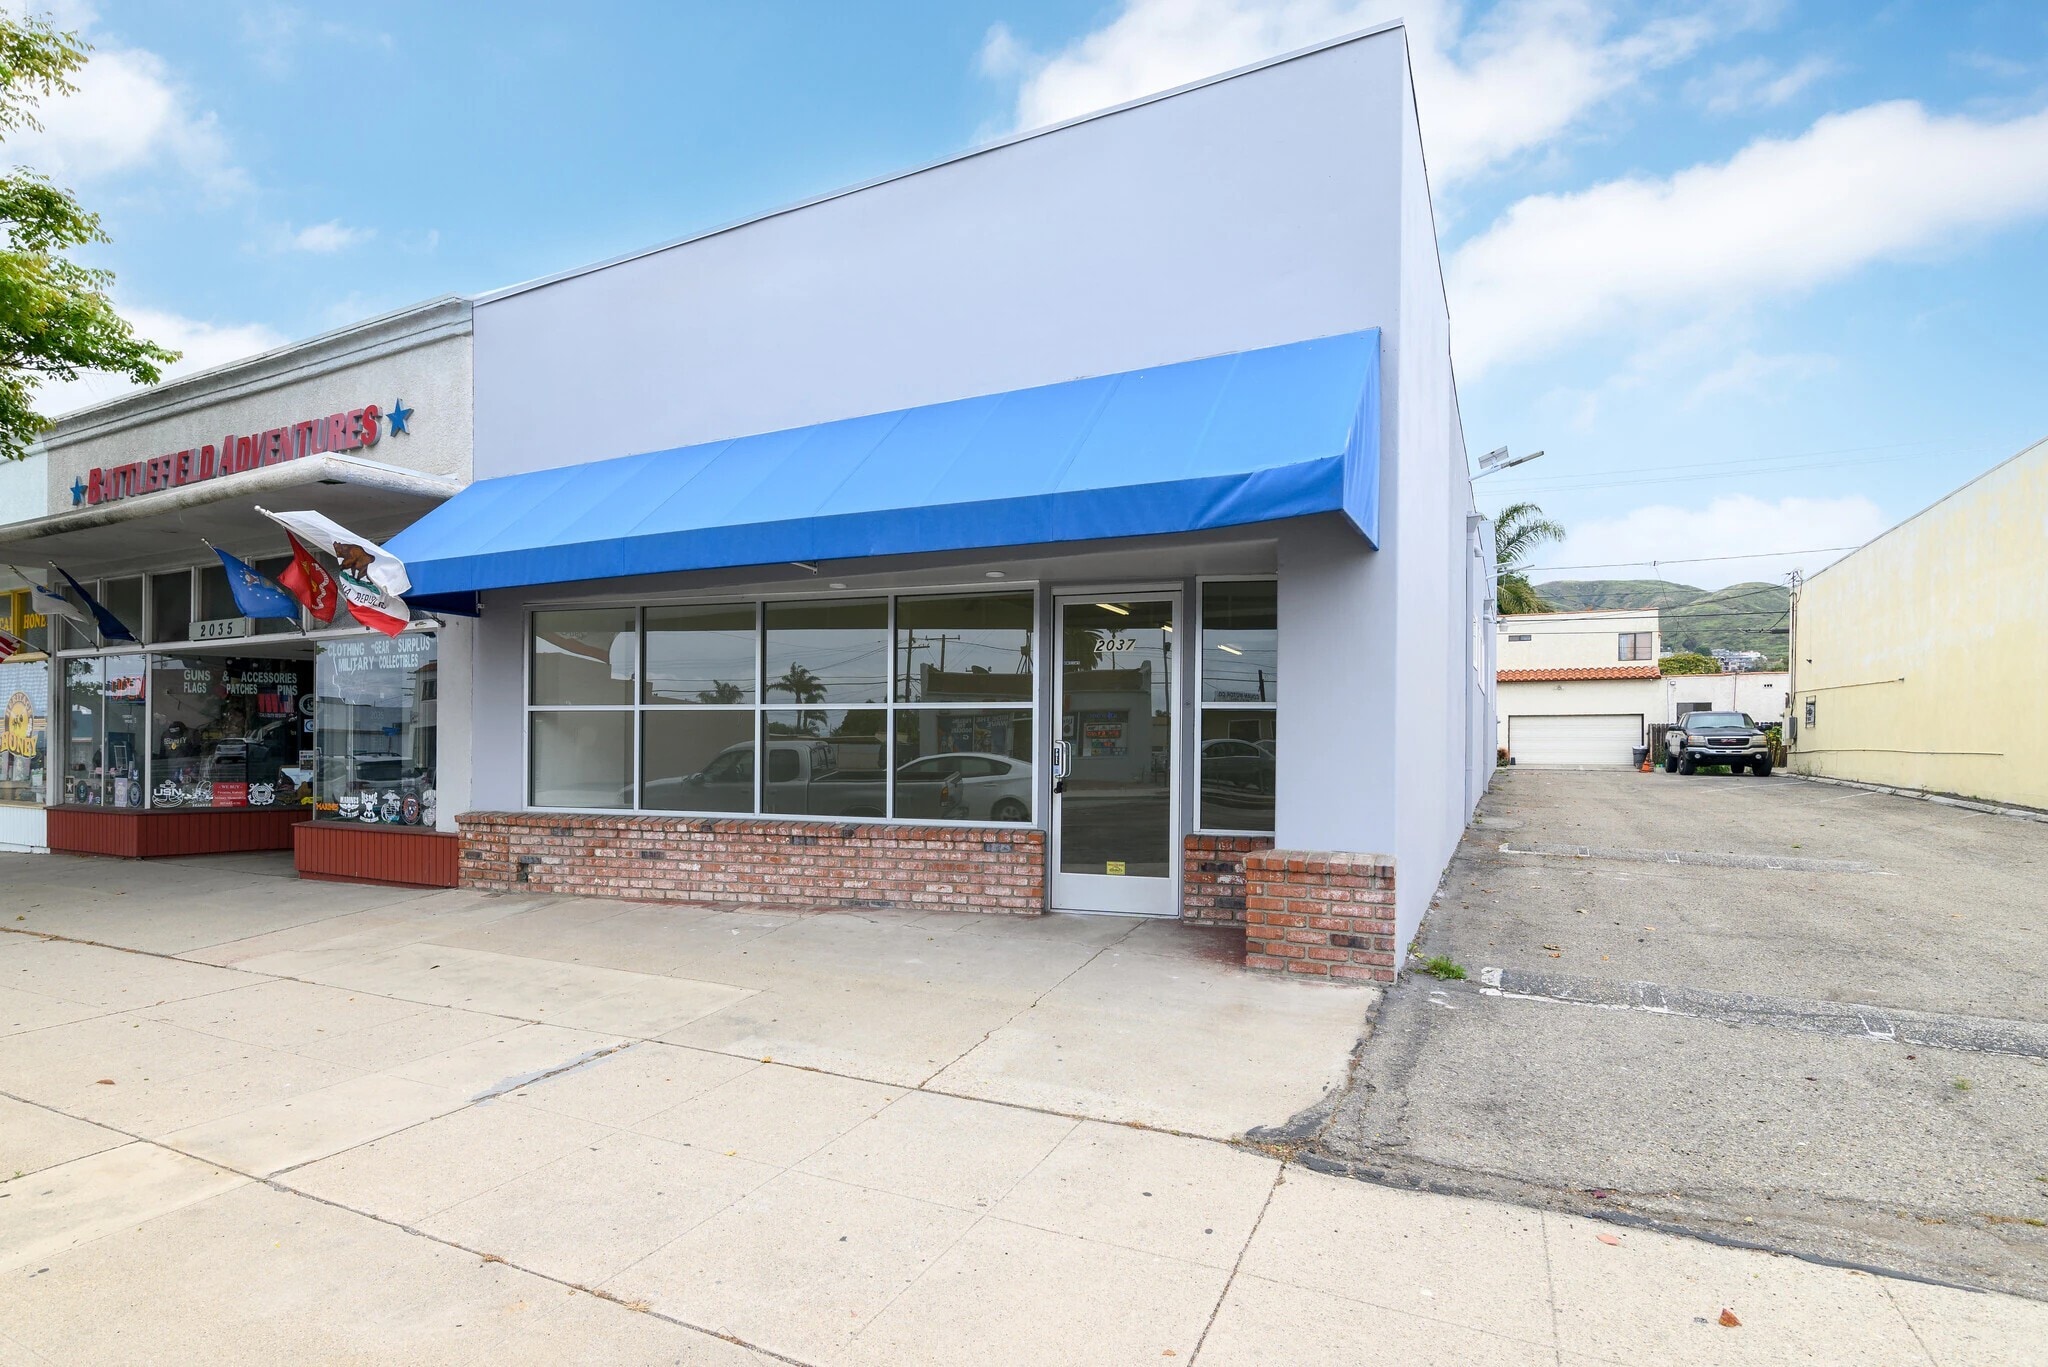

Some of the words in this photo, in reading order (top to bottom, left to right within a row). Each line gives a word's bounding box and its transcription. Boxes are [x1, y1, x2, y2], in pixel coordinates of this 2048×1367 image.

[88, 444, 218, 504] BATTLEFIELD
[219, 404, 382, 477] ADVENTURES
[24, 613, 48, 629] HONE
[200, 622, 233, 637] 2035
[327, 642, 365, 657] CLOTHING
[374, 641, 390, 654] GEAR
[397, 637, 431, 652] SURPLUS
[1095, 638, 1137, 651] 2037
[338, 656, 374, 672] MILITARY
[378, 654, 419, 669] COLLECTIBLES
[183, 670, 211, 681] GUNS
[222, 670, 230, 681] &
[241, 671, 297, 684] ACCESSORIES
[183, 682, 207, 693] FLAGS
[226, 683, 258, 695] PATCHES
[277, 685, 298, 696] PINS
[1, 731, 38, 758] HONEY
[153, 788, 182, 796] USN
